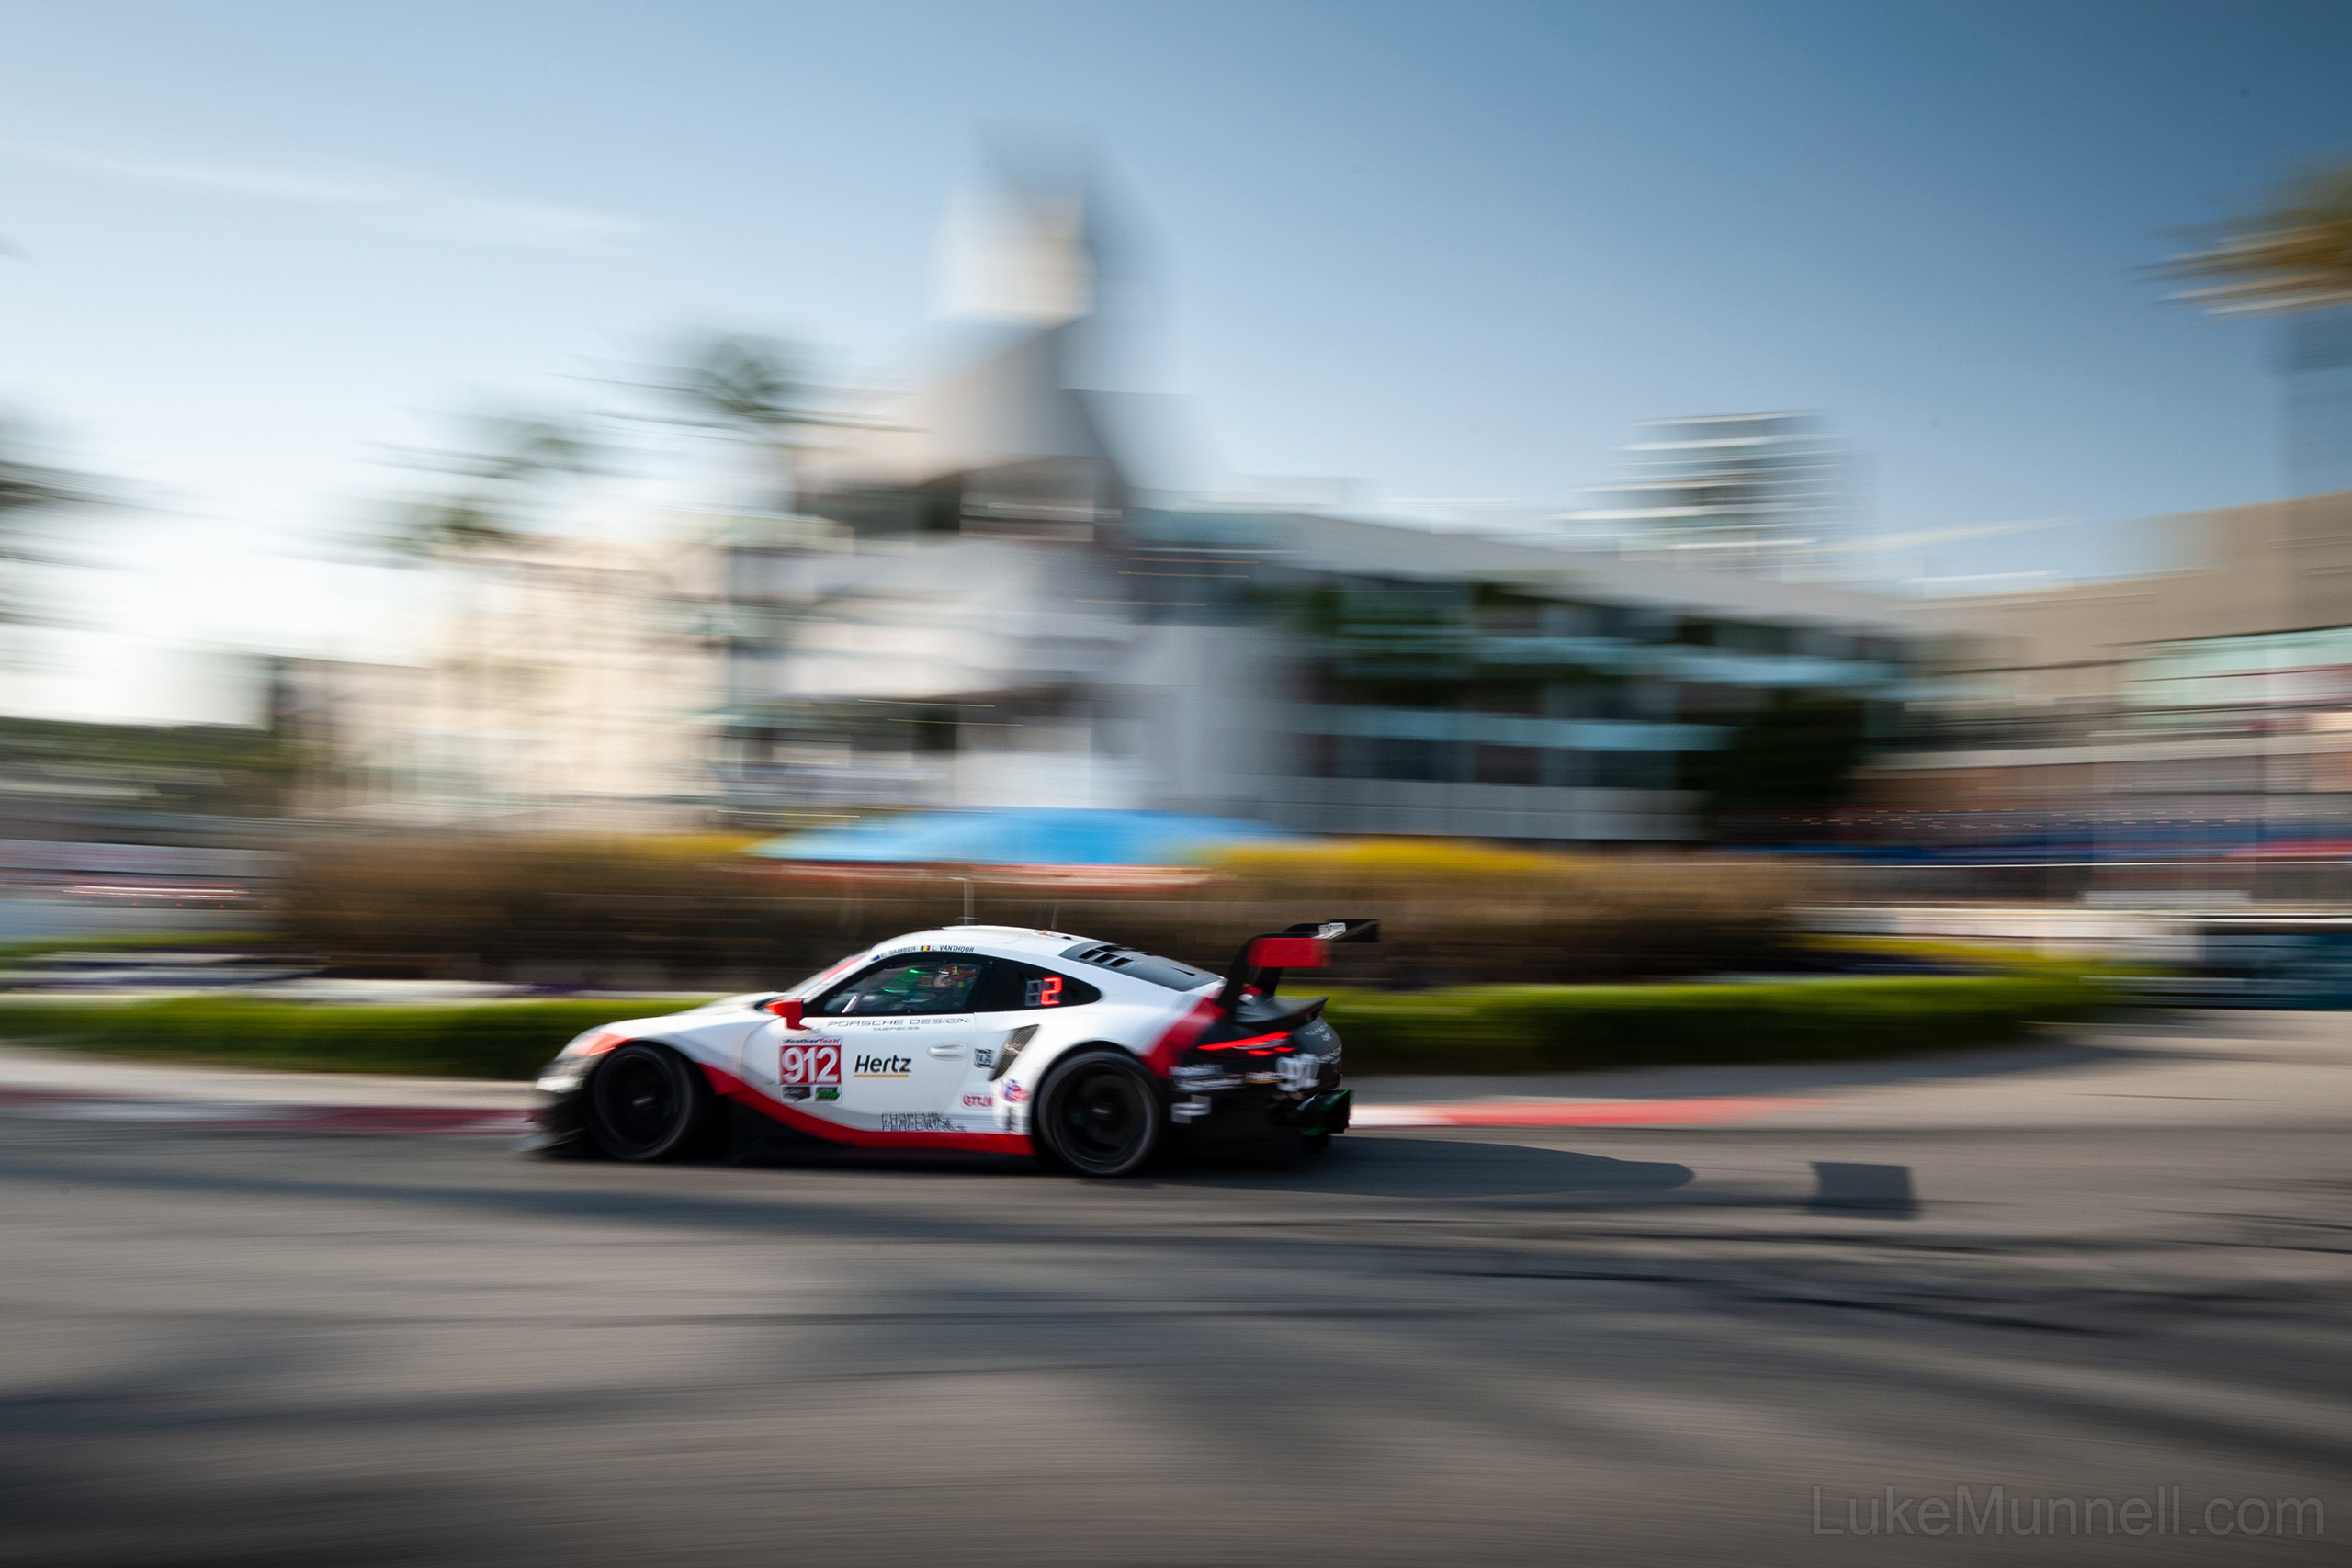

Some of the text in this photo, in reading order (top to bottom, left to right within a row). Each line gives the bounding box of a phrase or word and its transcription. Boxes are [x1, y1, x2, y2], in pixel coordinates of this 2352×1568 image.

[939, 945, 975, 953] VANTHOOR
[827, 1017, 969, 1028] PORSCHE DESIGN
[781, 1046, 839, 1084] 912
[854, 1055, 912, 1073] Hertz
